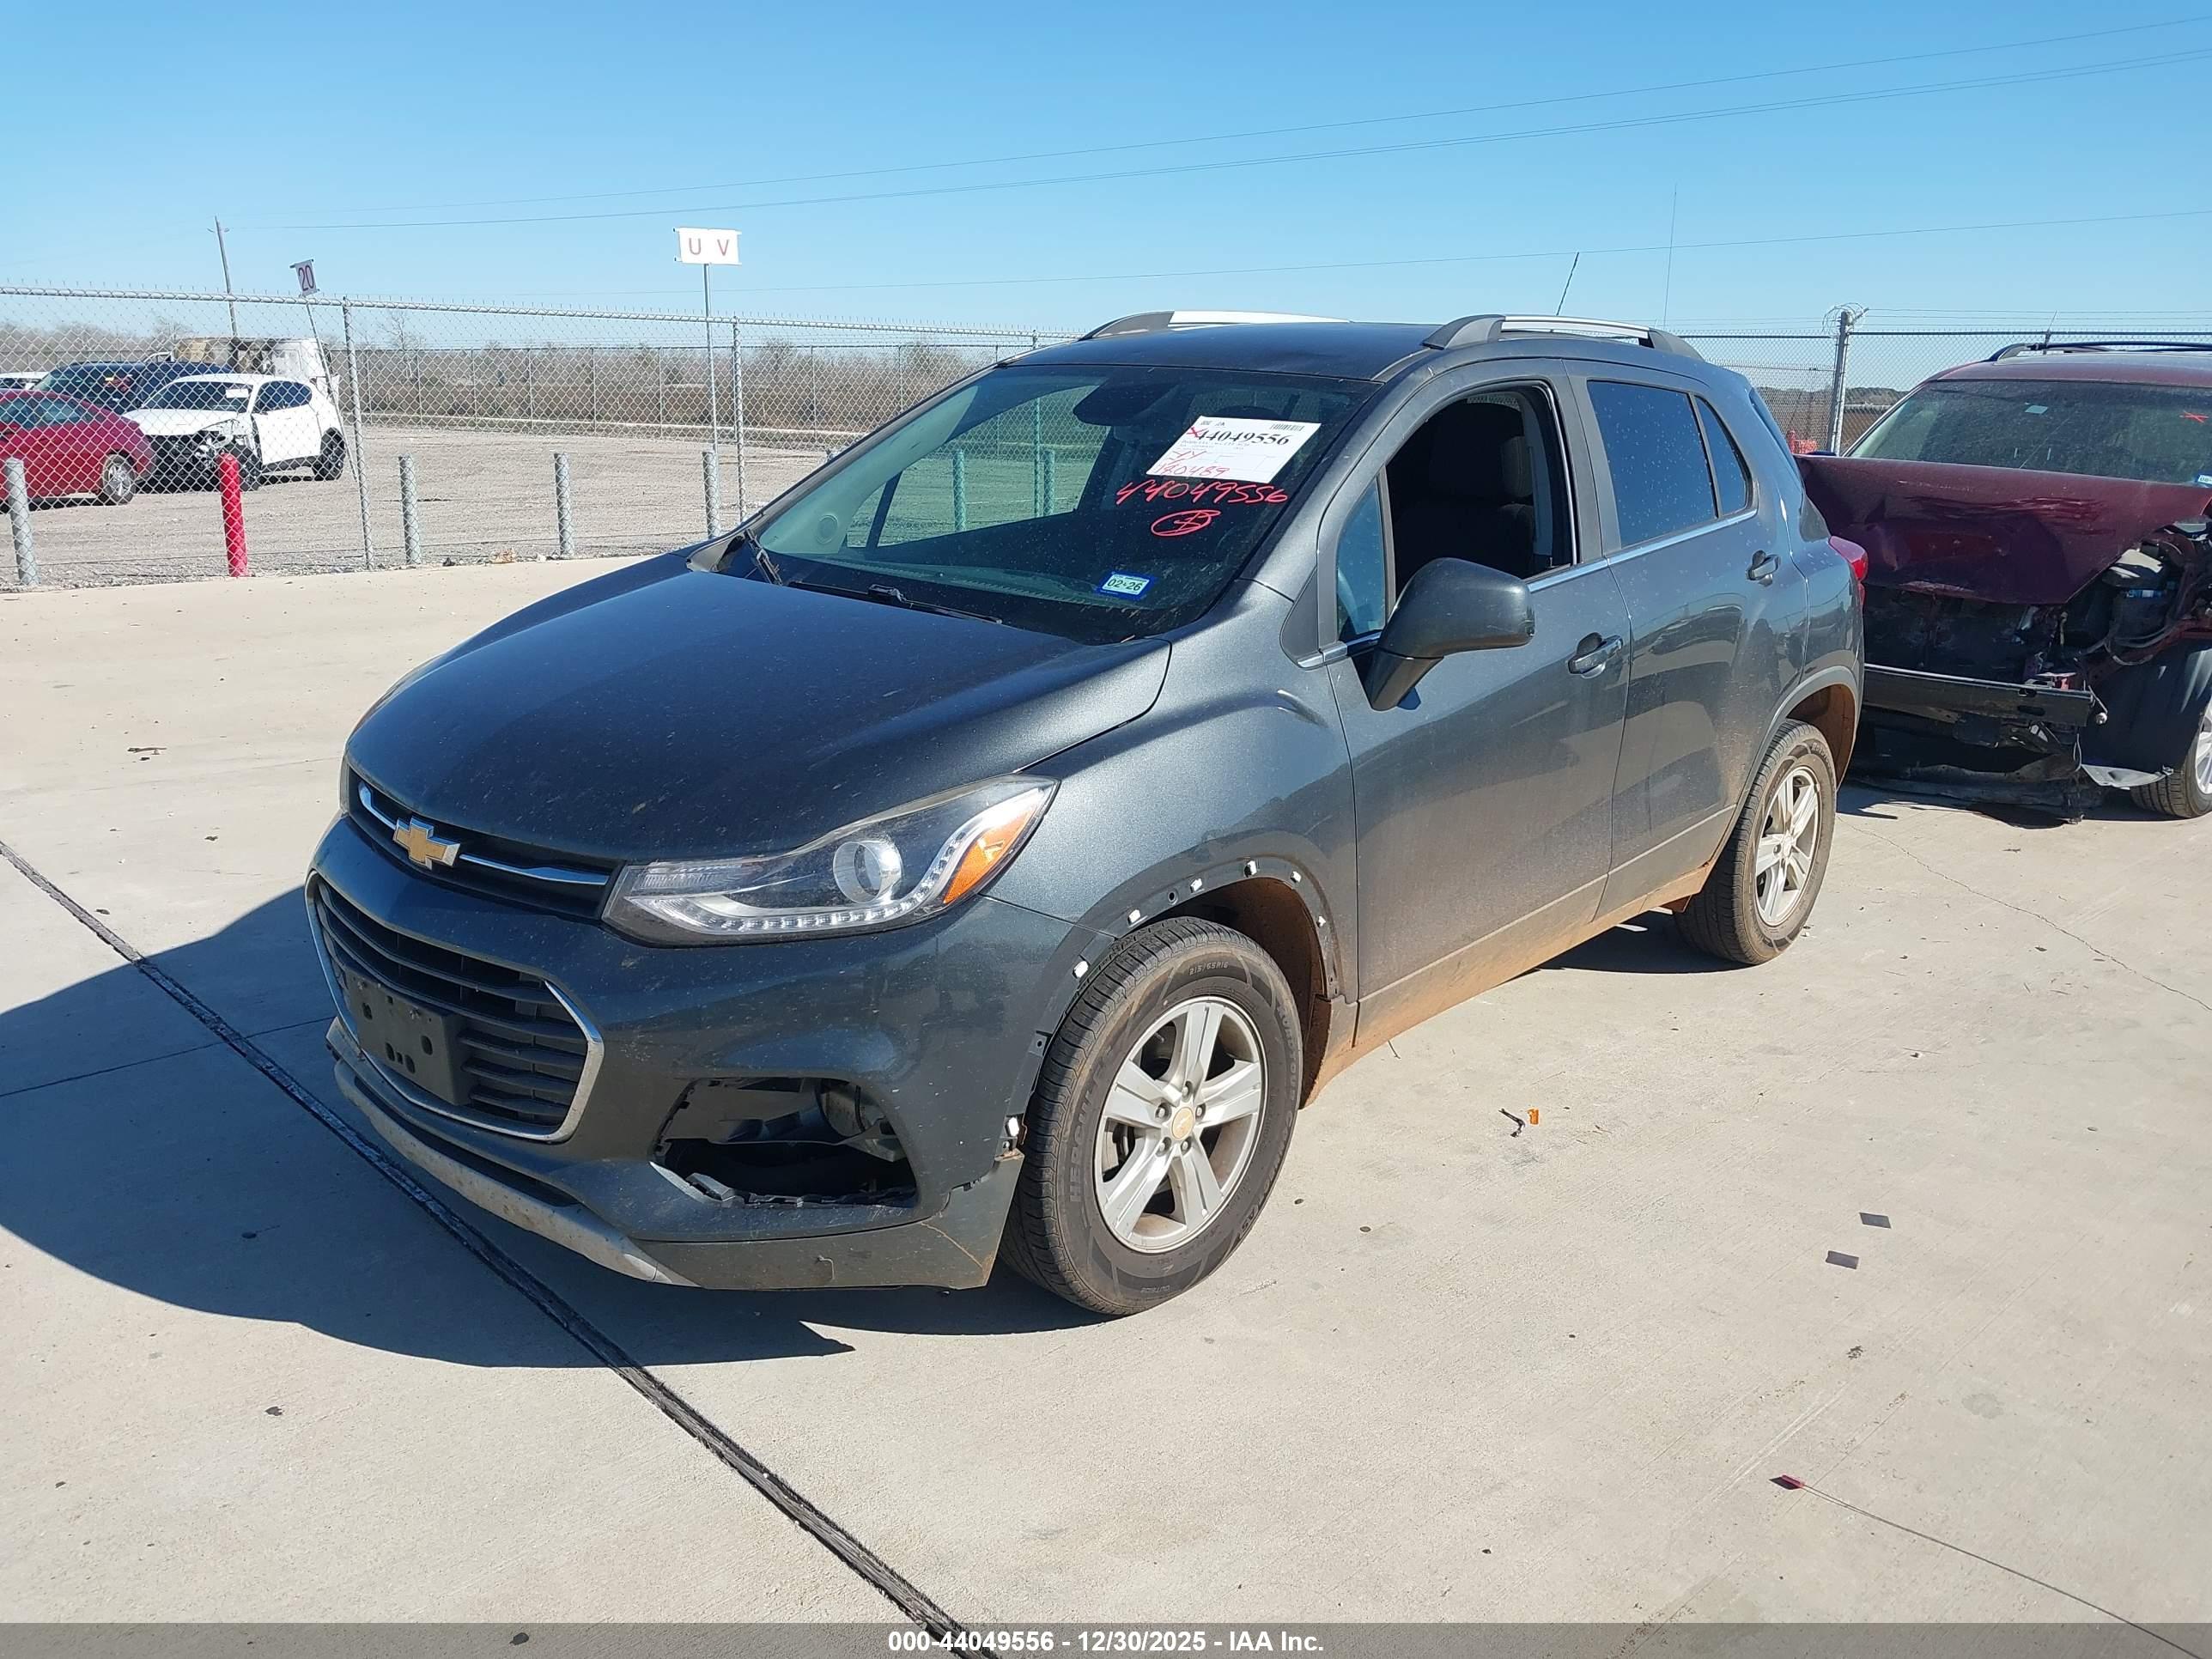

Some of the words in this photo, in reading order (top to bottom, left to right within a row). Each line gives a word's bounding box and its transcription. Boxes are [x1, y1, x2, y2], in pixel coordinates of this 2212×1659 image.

[689, 238, 702, 255] U
[716, 239, 730, 257] V
[298, 264, 314, 291] 20
[1197, 429, 1292, 446] 44049556
[1116, 479, 1289, 505] 44049556
